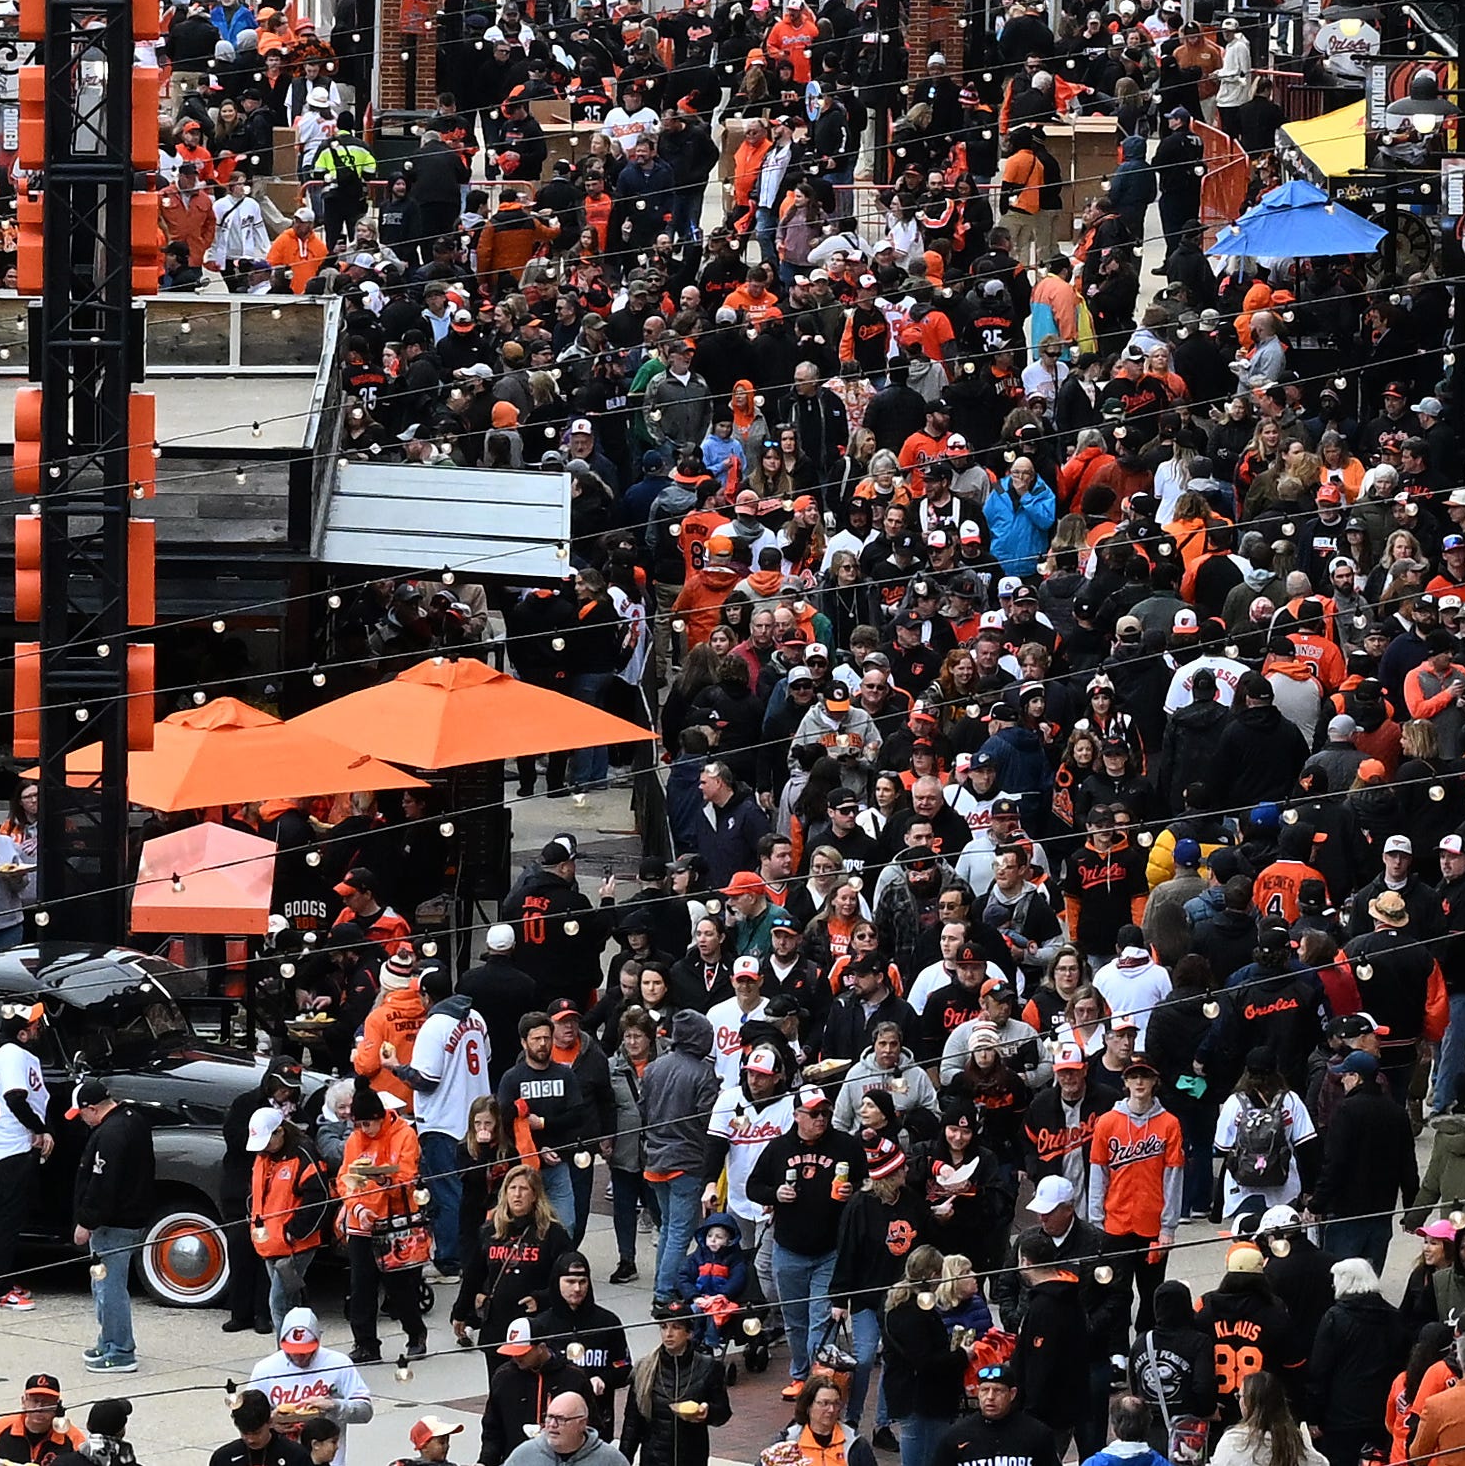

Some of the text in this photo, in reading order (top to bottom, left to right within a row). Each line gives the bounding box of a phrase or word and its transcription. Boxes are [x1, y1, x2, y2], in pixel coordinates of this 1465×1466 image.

[689, 540, 705, 570] 8
[284, 899, 327, 919] BOOG'S
[1264, 892, 1284, 917] 4
[524, 912, 546, 945] 10
[1245, 997, 1298, 1020] Orioles
[465, 1040, 481, 1075] 6
[520, 1079, 564, 1101] 2131
[1214, 1320, 1261, 1342] KLAUS
